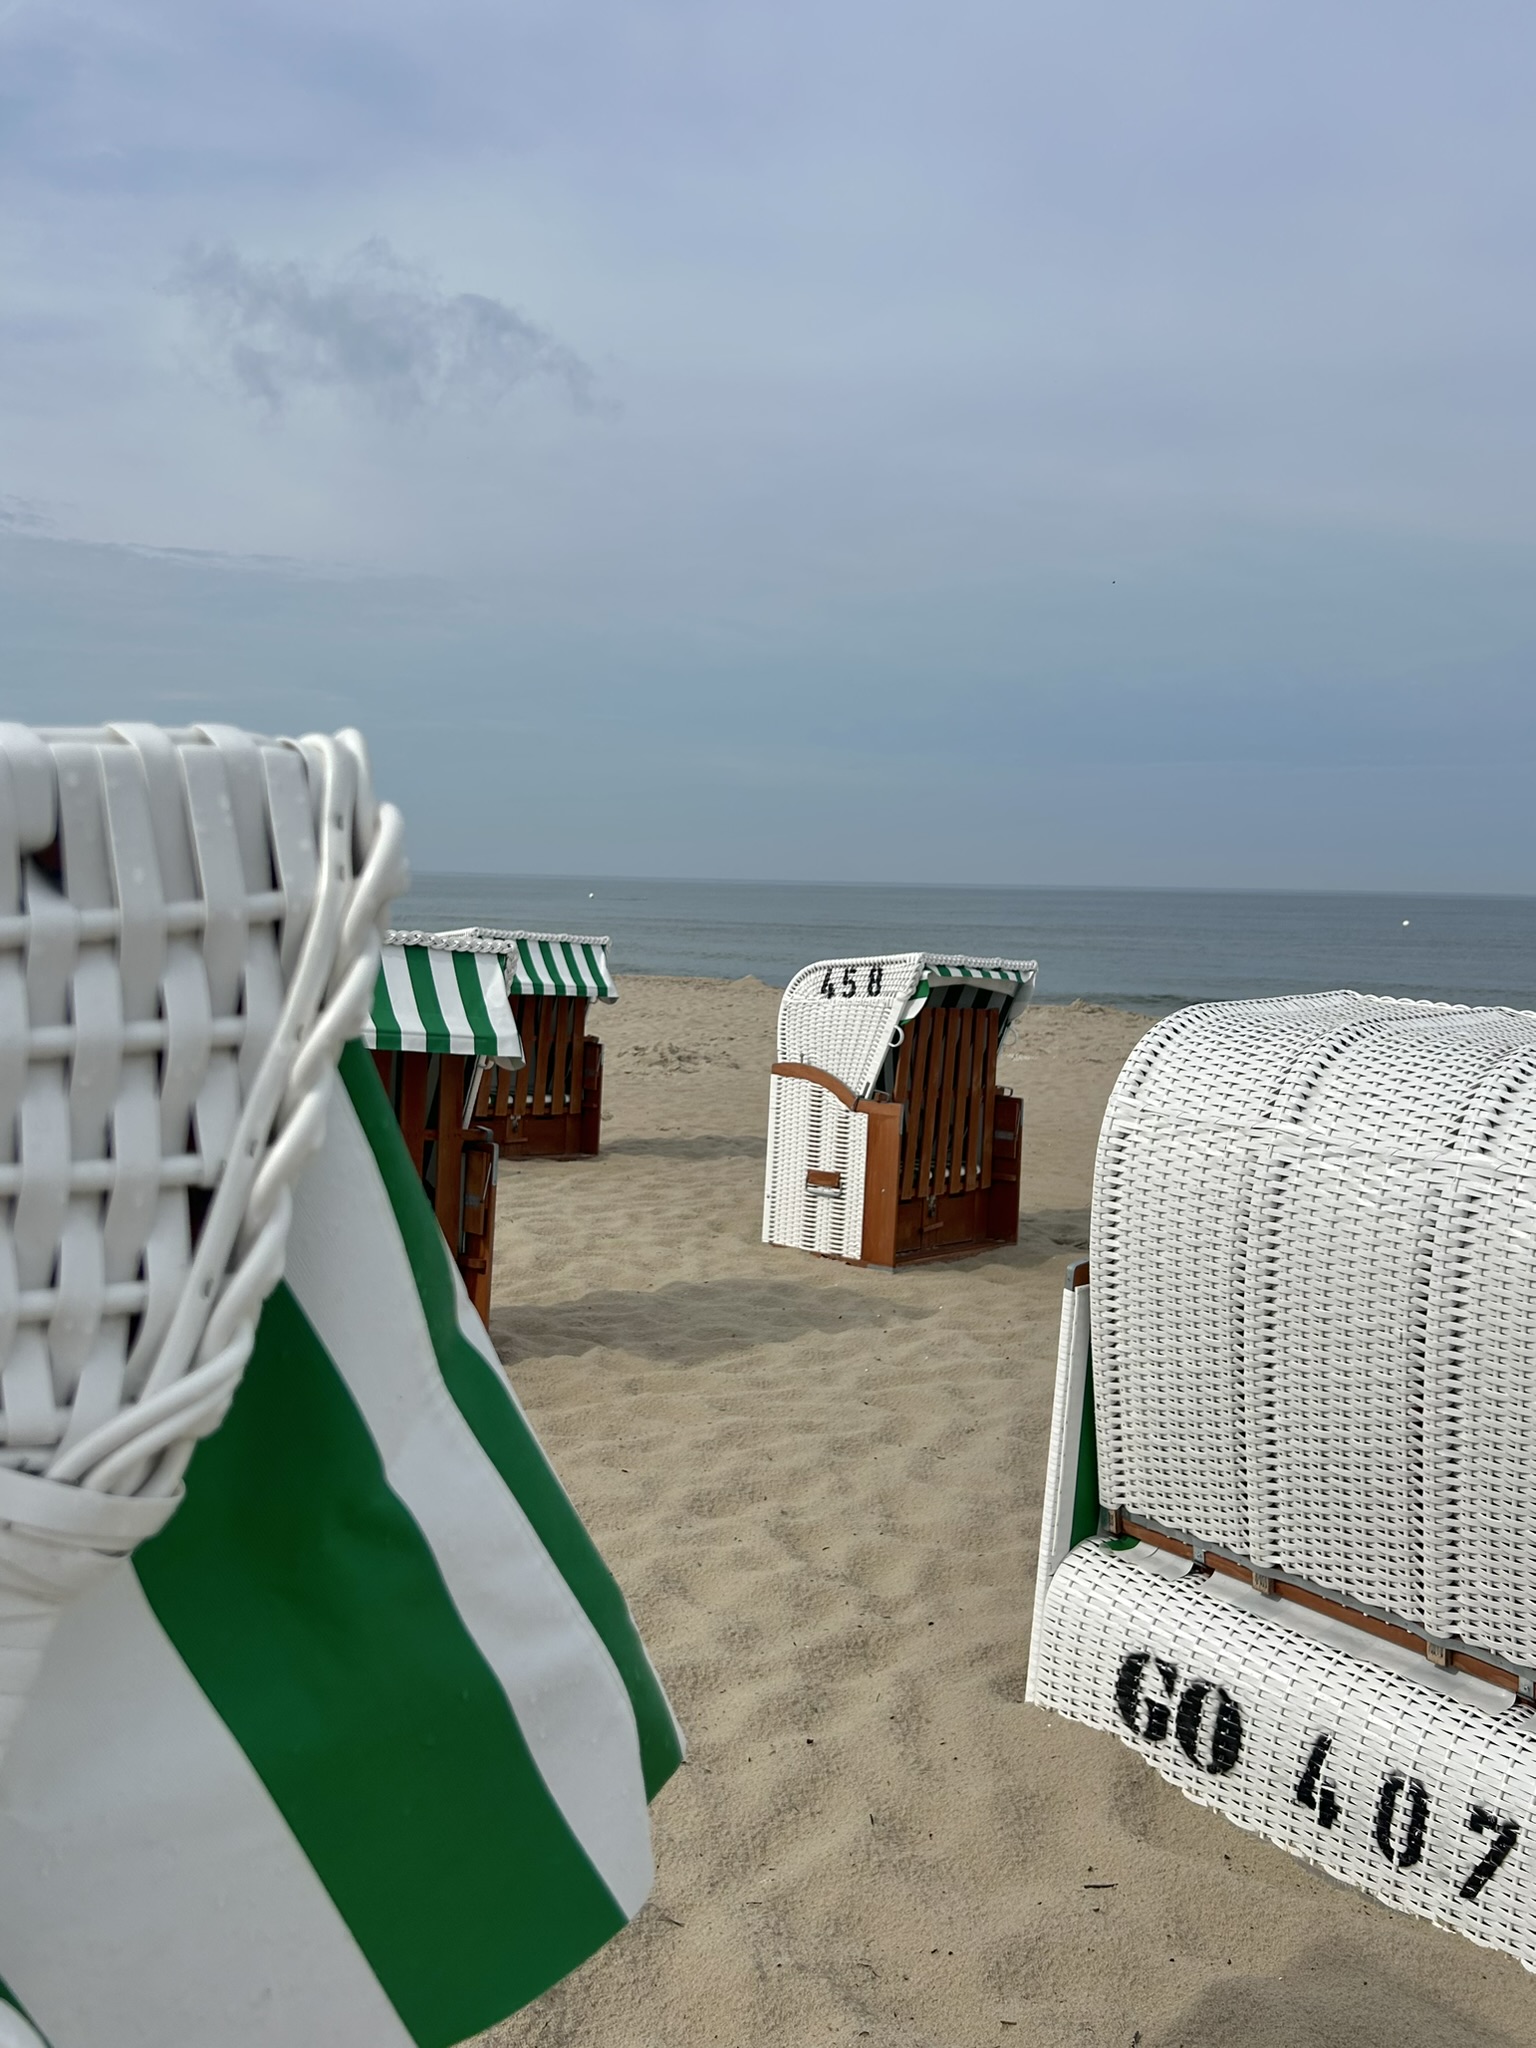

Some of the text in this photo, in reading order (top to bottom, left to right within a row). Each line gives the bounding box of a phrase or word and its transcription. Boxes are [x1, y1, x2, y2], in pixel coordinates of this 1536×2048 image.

[820, 965, 883, 998] 458
[1116, 1652, 1519, 1898] GO 407
